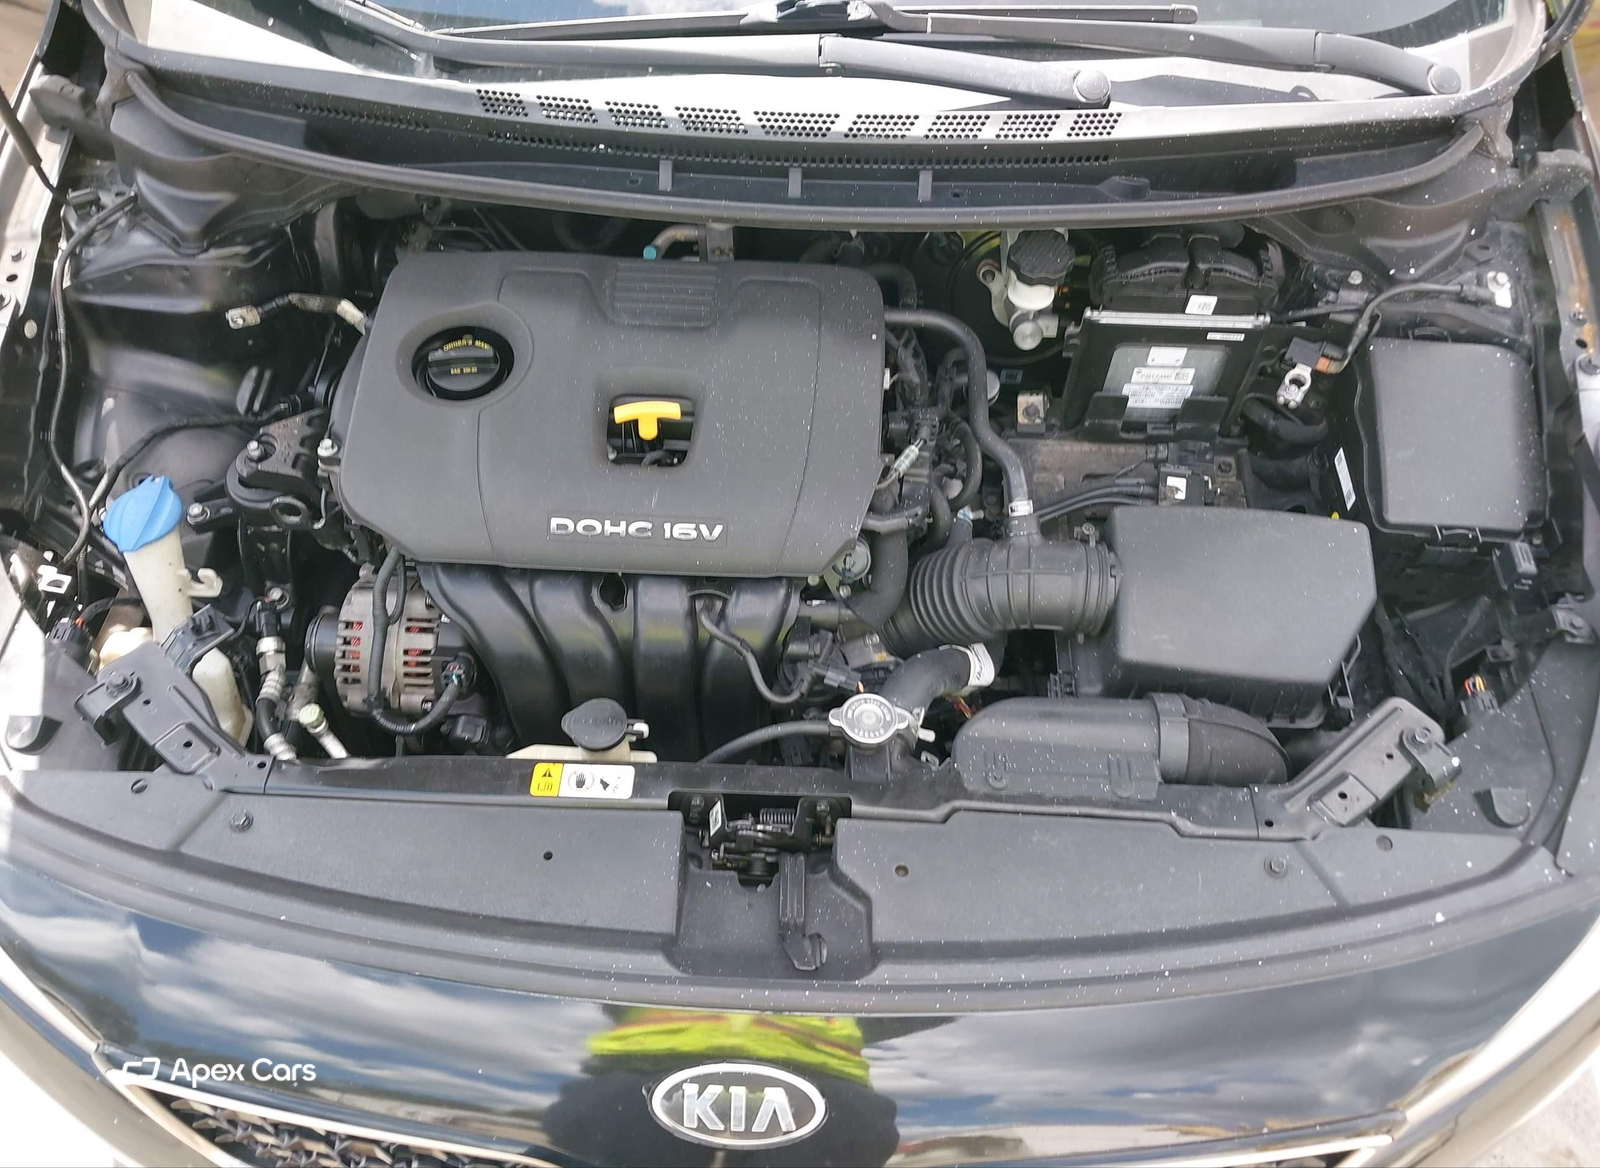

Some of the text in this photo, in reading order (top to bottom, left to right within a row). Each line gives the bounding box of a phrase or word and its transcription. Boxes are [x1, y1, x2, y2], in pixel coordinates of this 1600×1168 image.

[550, 517, 724, 542] DOHC 16V
[682, 1083, 796, 1133] KIA
